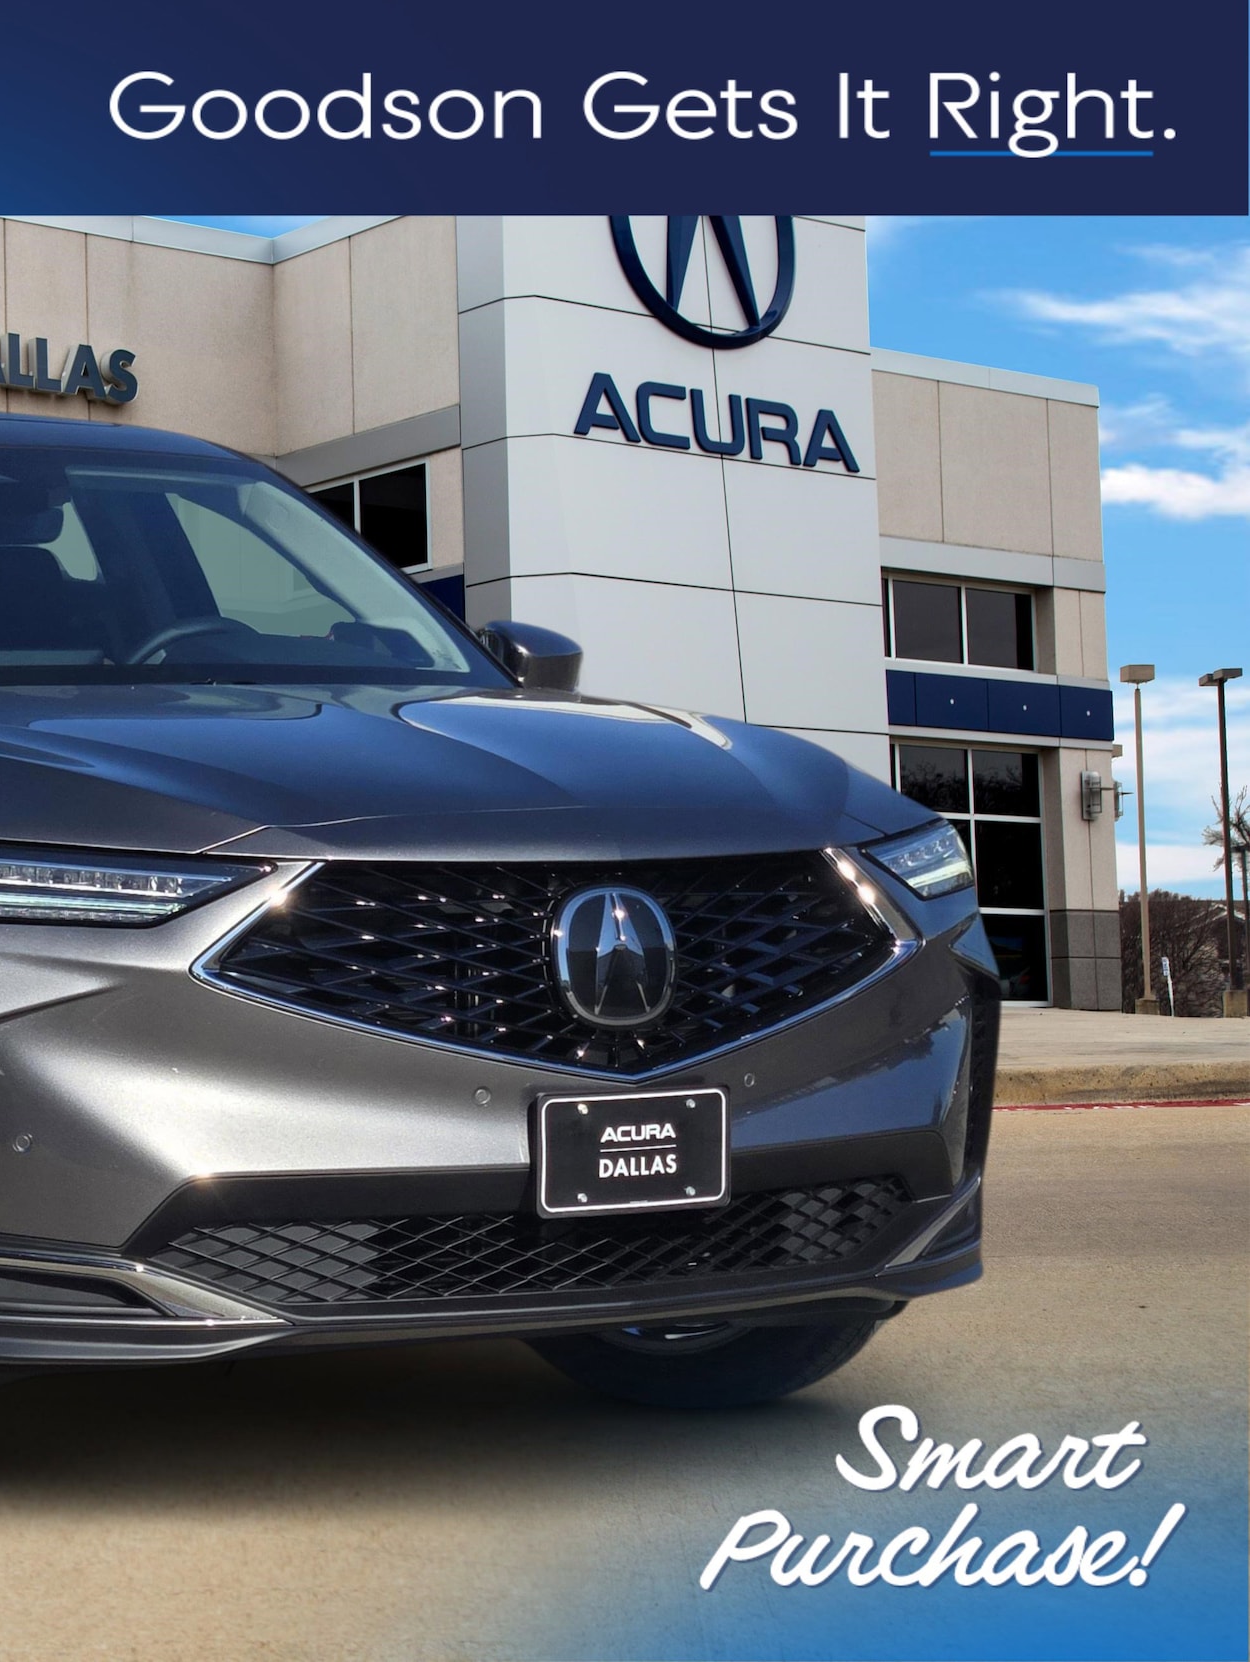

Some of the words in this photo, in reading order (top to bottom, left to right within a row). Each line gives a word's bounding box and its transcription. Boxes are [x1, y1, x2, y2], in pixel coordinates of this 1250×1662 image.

[573, 372, 860, 473] ACURA
[600, 1122, 677, 1143] ACURA
[599, 1153, 678, 1178] DALLAS
